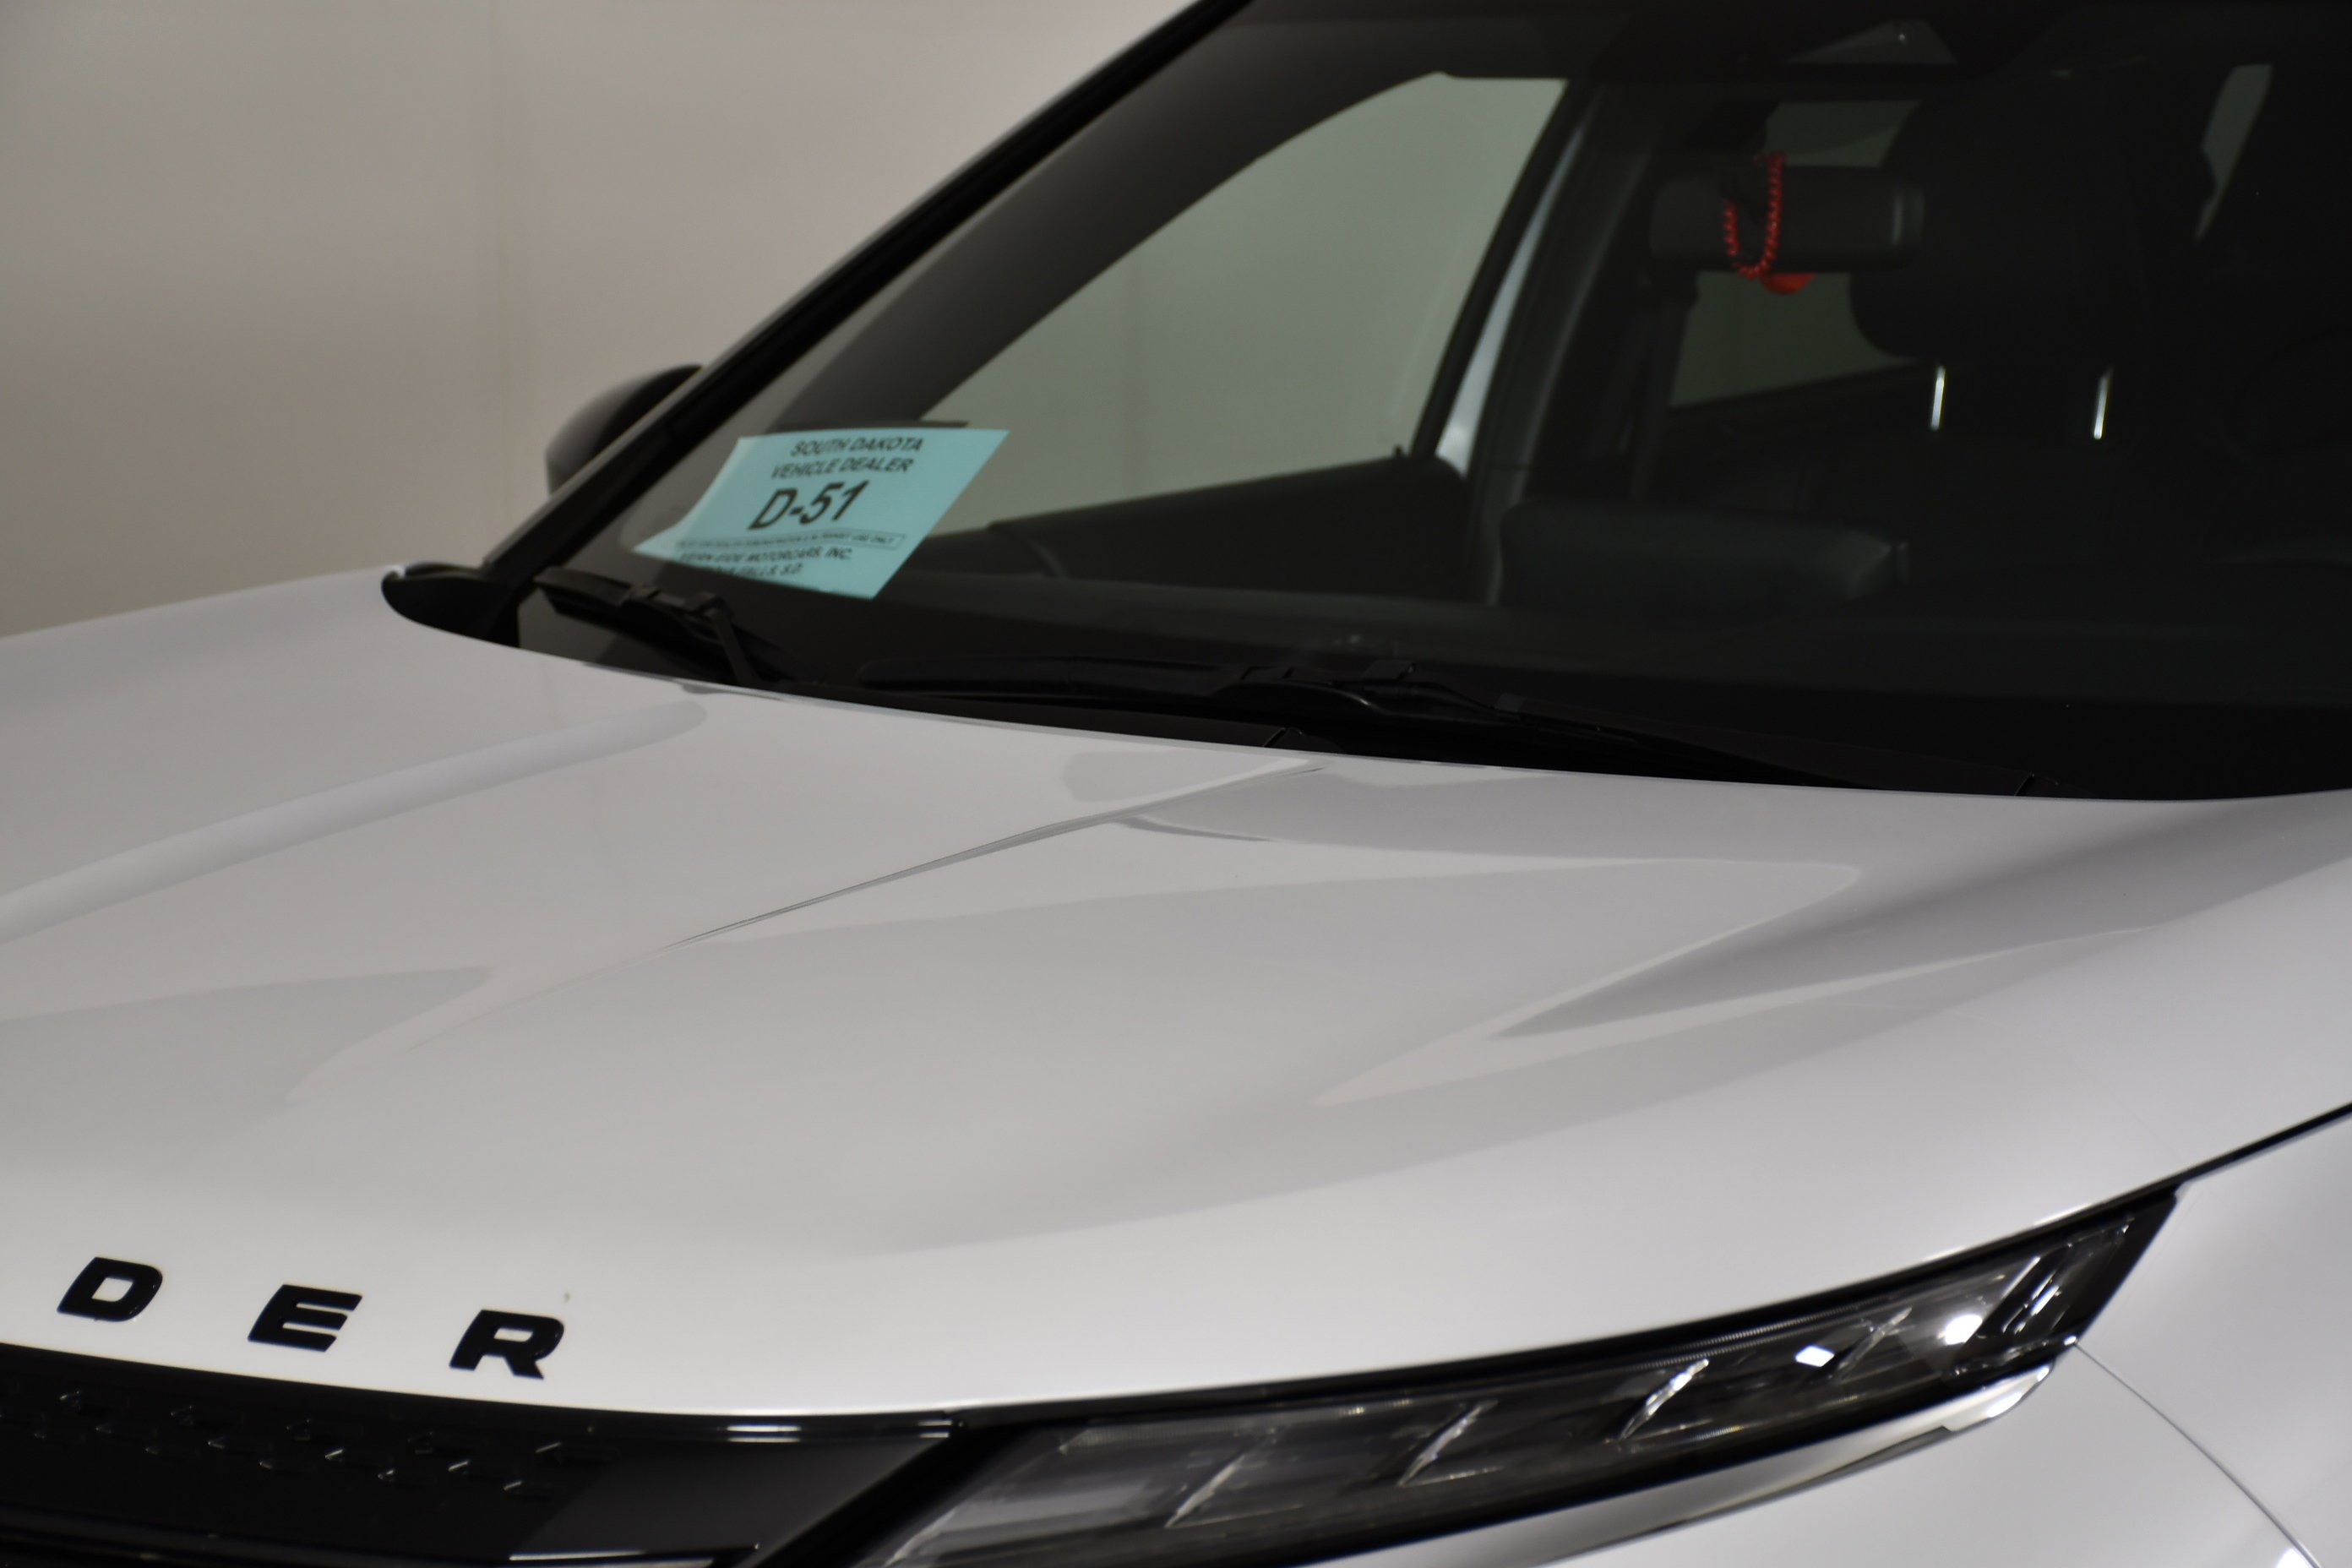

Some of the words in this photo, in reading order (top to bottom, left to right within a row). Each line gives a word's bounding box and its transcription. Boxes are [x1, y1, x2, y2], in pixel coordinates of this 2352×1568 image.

[791, 438, 849, 457] SOUTH
[849, 437, 923, 453] DAKOTA
[771, 458, 840, 479] VEHICLE
[839, 457, 914, 473] DEALER
[747, 479, 869, 531] D-51
